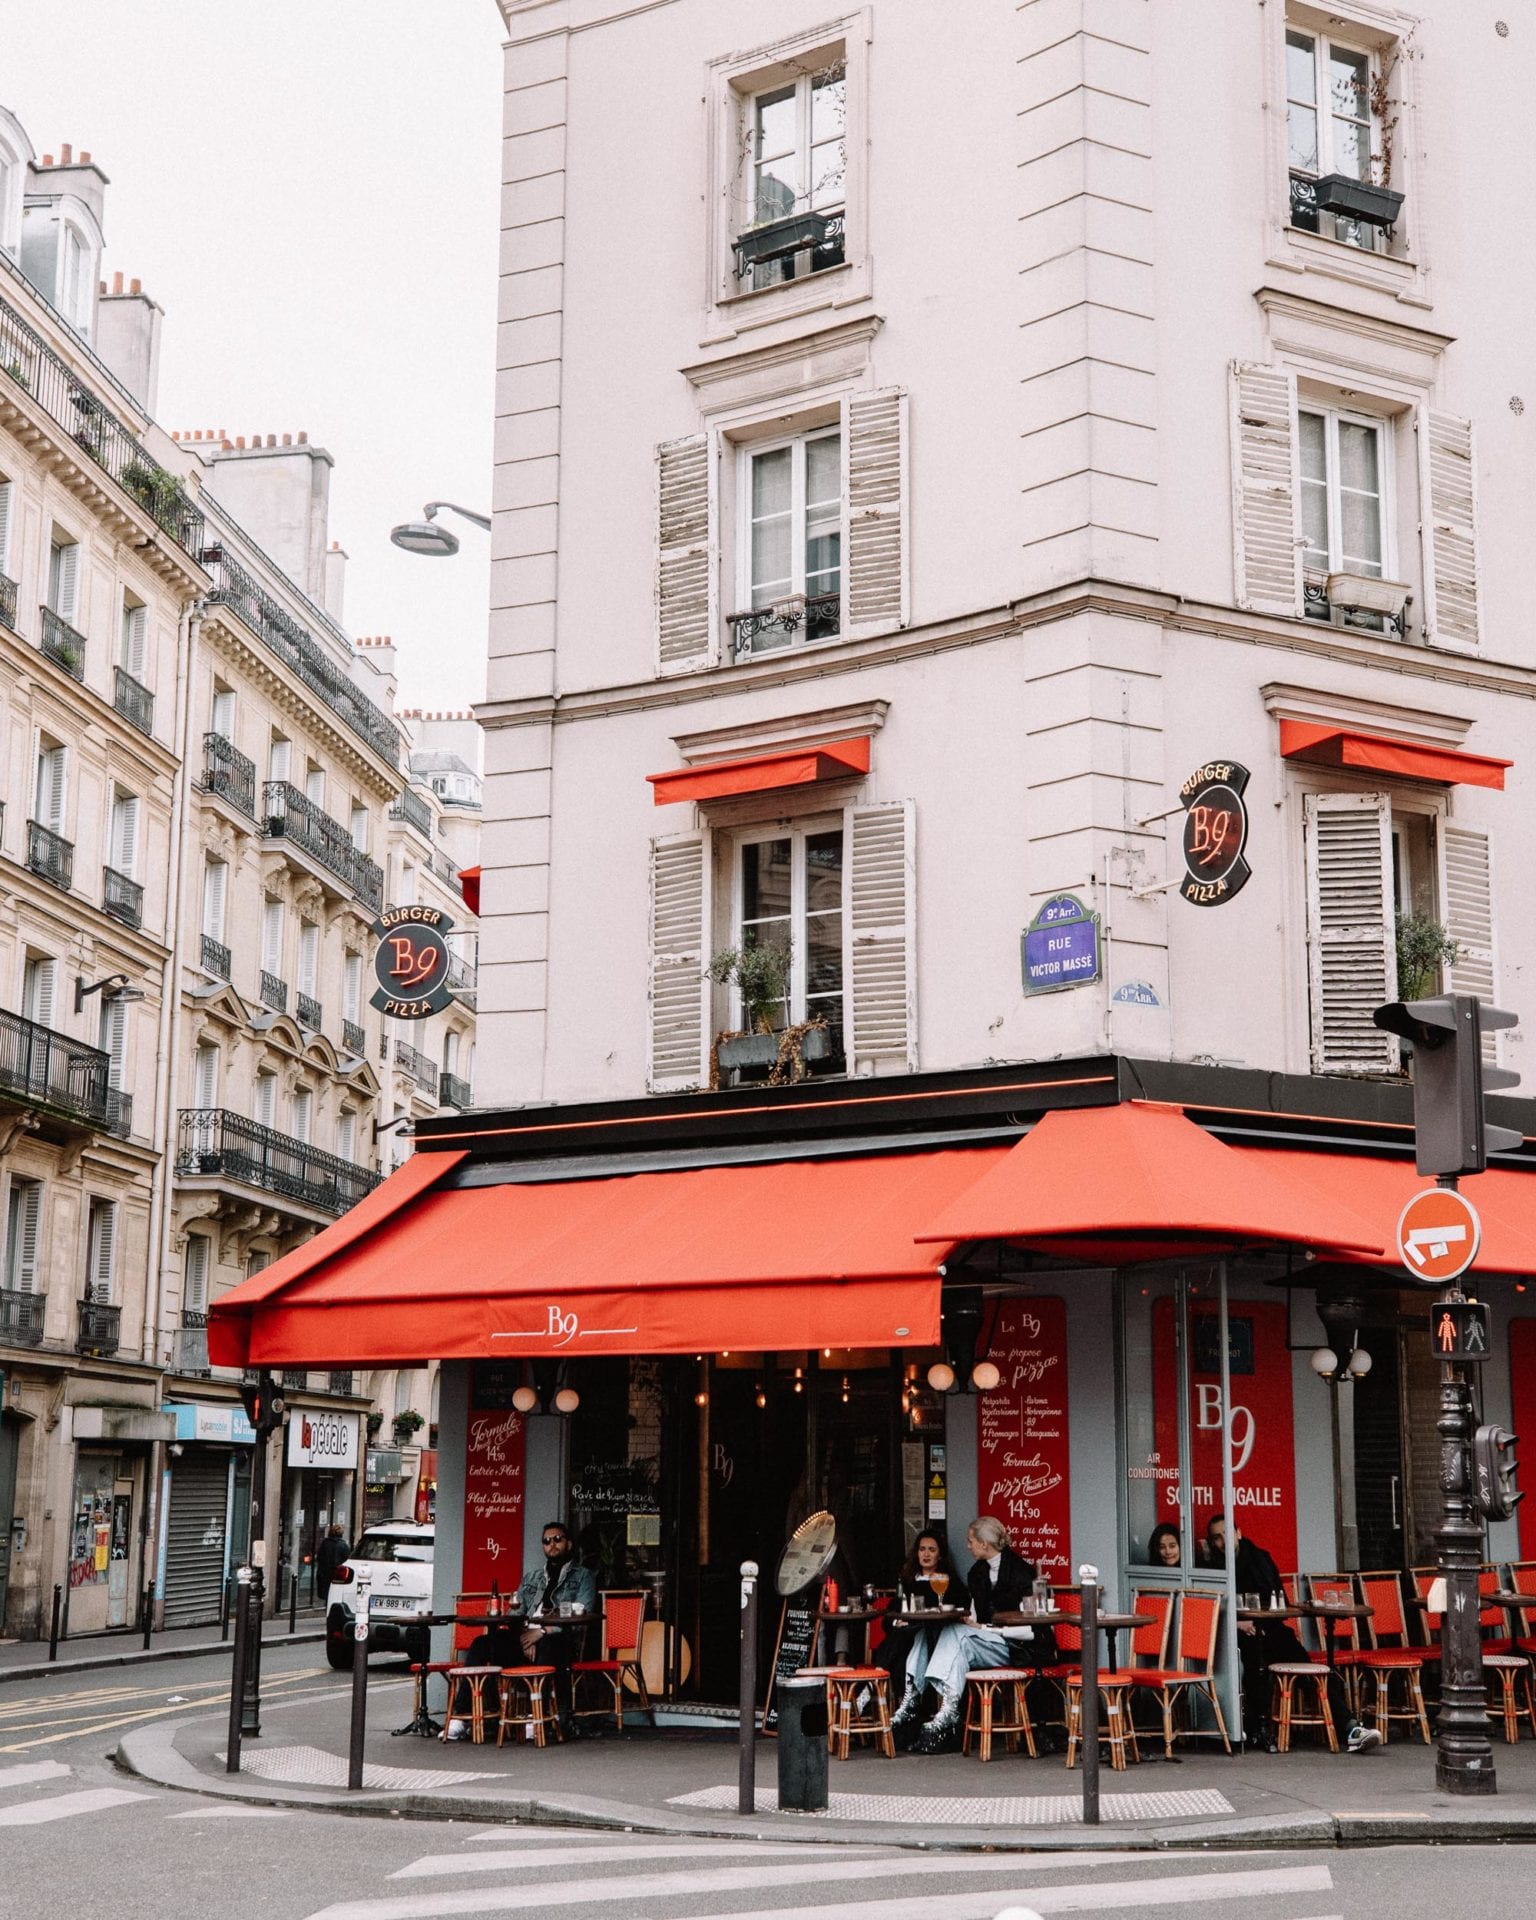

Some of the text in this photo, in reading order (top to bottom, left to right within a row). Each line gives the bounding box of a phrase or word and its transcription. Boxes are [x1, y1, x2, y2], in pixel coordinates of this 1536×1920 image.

[1181, 763, 1231, 795] BURGER
[1188, 806, 1229, 865] B9
[1186, 879, 1227, 901] PIZZA
[380, 907, 441, 927] BURGER
[1048, 936, 1072, 951] RUE
[389, 938, 437, 986] B9
[1030, 961, 1060, 977] VICTOR
[384, 1000, 432, 1016] PIZZA
[547, 1305, 578, 1348] B9
[1001, 1313, 1041, 1339] Le B9
[1009, 1347, 1042, 1362] propose
[1012, 1355, 1058, 1389] pizzas
[469, 1412, 517, 1452] Formule
[1195, 1384, 1256, 1473] B9
[982, 1439, 999, 1454] Chef
[714, 1443, 734, 1489] B9
[1003, 1452, 1041, 1467] Formule
[1147, 1453, 1161, 1465] AIR
[988, 1474, 1031, 1505] pizza
[1022, 1527, 1036, 1535] au
[1038, 1523, 1060, 1535] choix
[487, 1538, 500, 1560] B9
[1019, 1538, 1030, 1548] de
